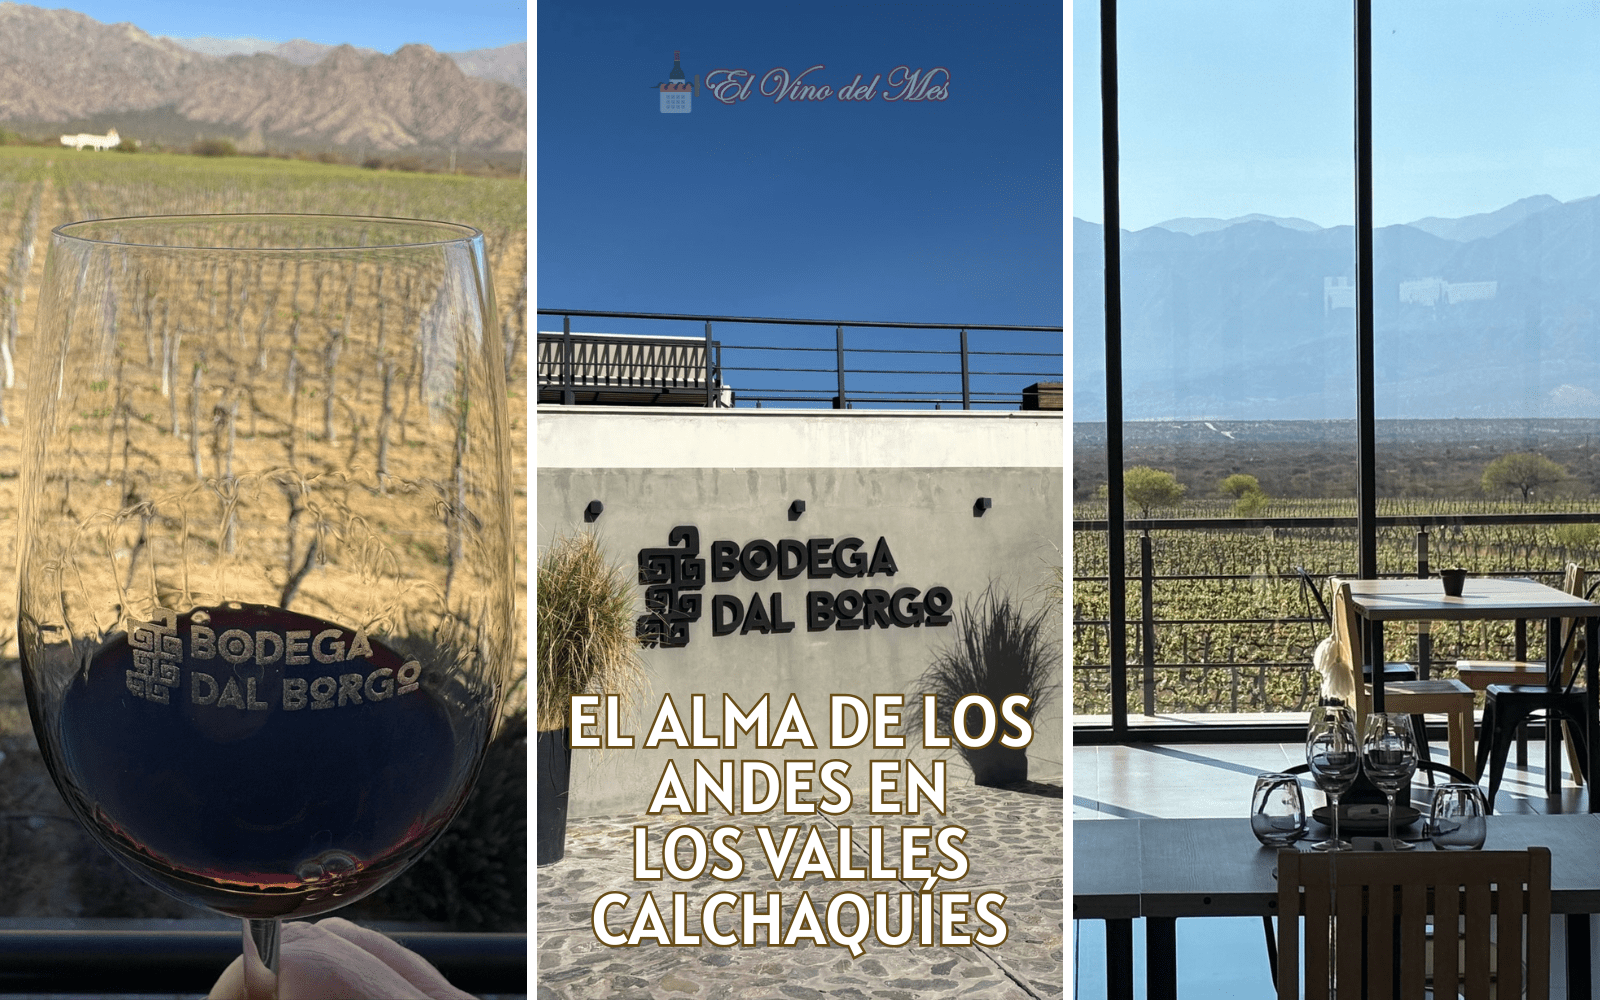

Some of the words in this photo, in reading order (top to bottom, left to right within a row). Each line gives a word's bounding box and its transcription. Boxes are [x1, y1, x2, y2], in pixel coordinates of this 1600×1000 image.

[711, 536, 899, 582] BODEGA
[712, 592, 796, 637] DAL
[806, 586, 953, 632] BORGO
[190, 624, 374, 666] BODEGA
[191, 671, 269, 711] DAL
[282, 660, 422, 711] BORGO
